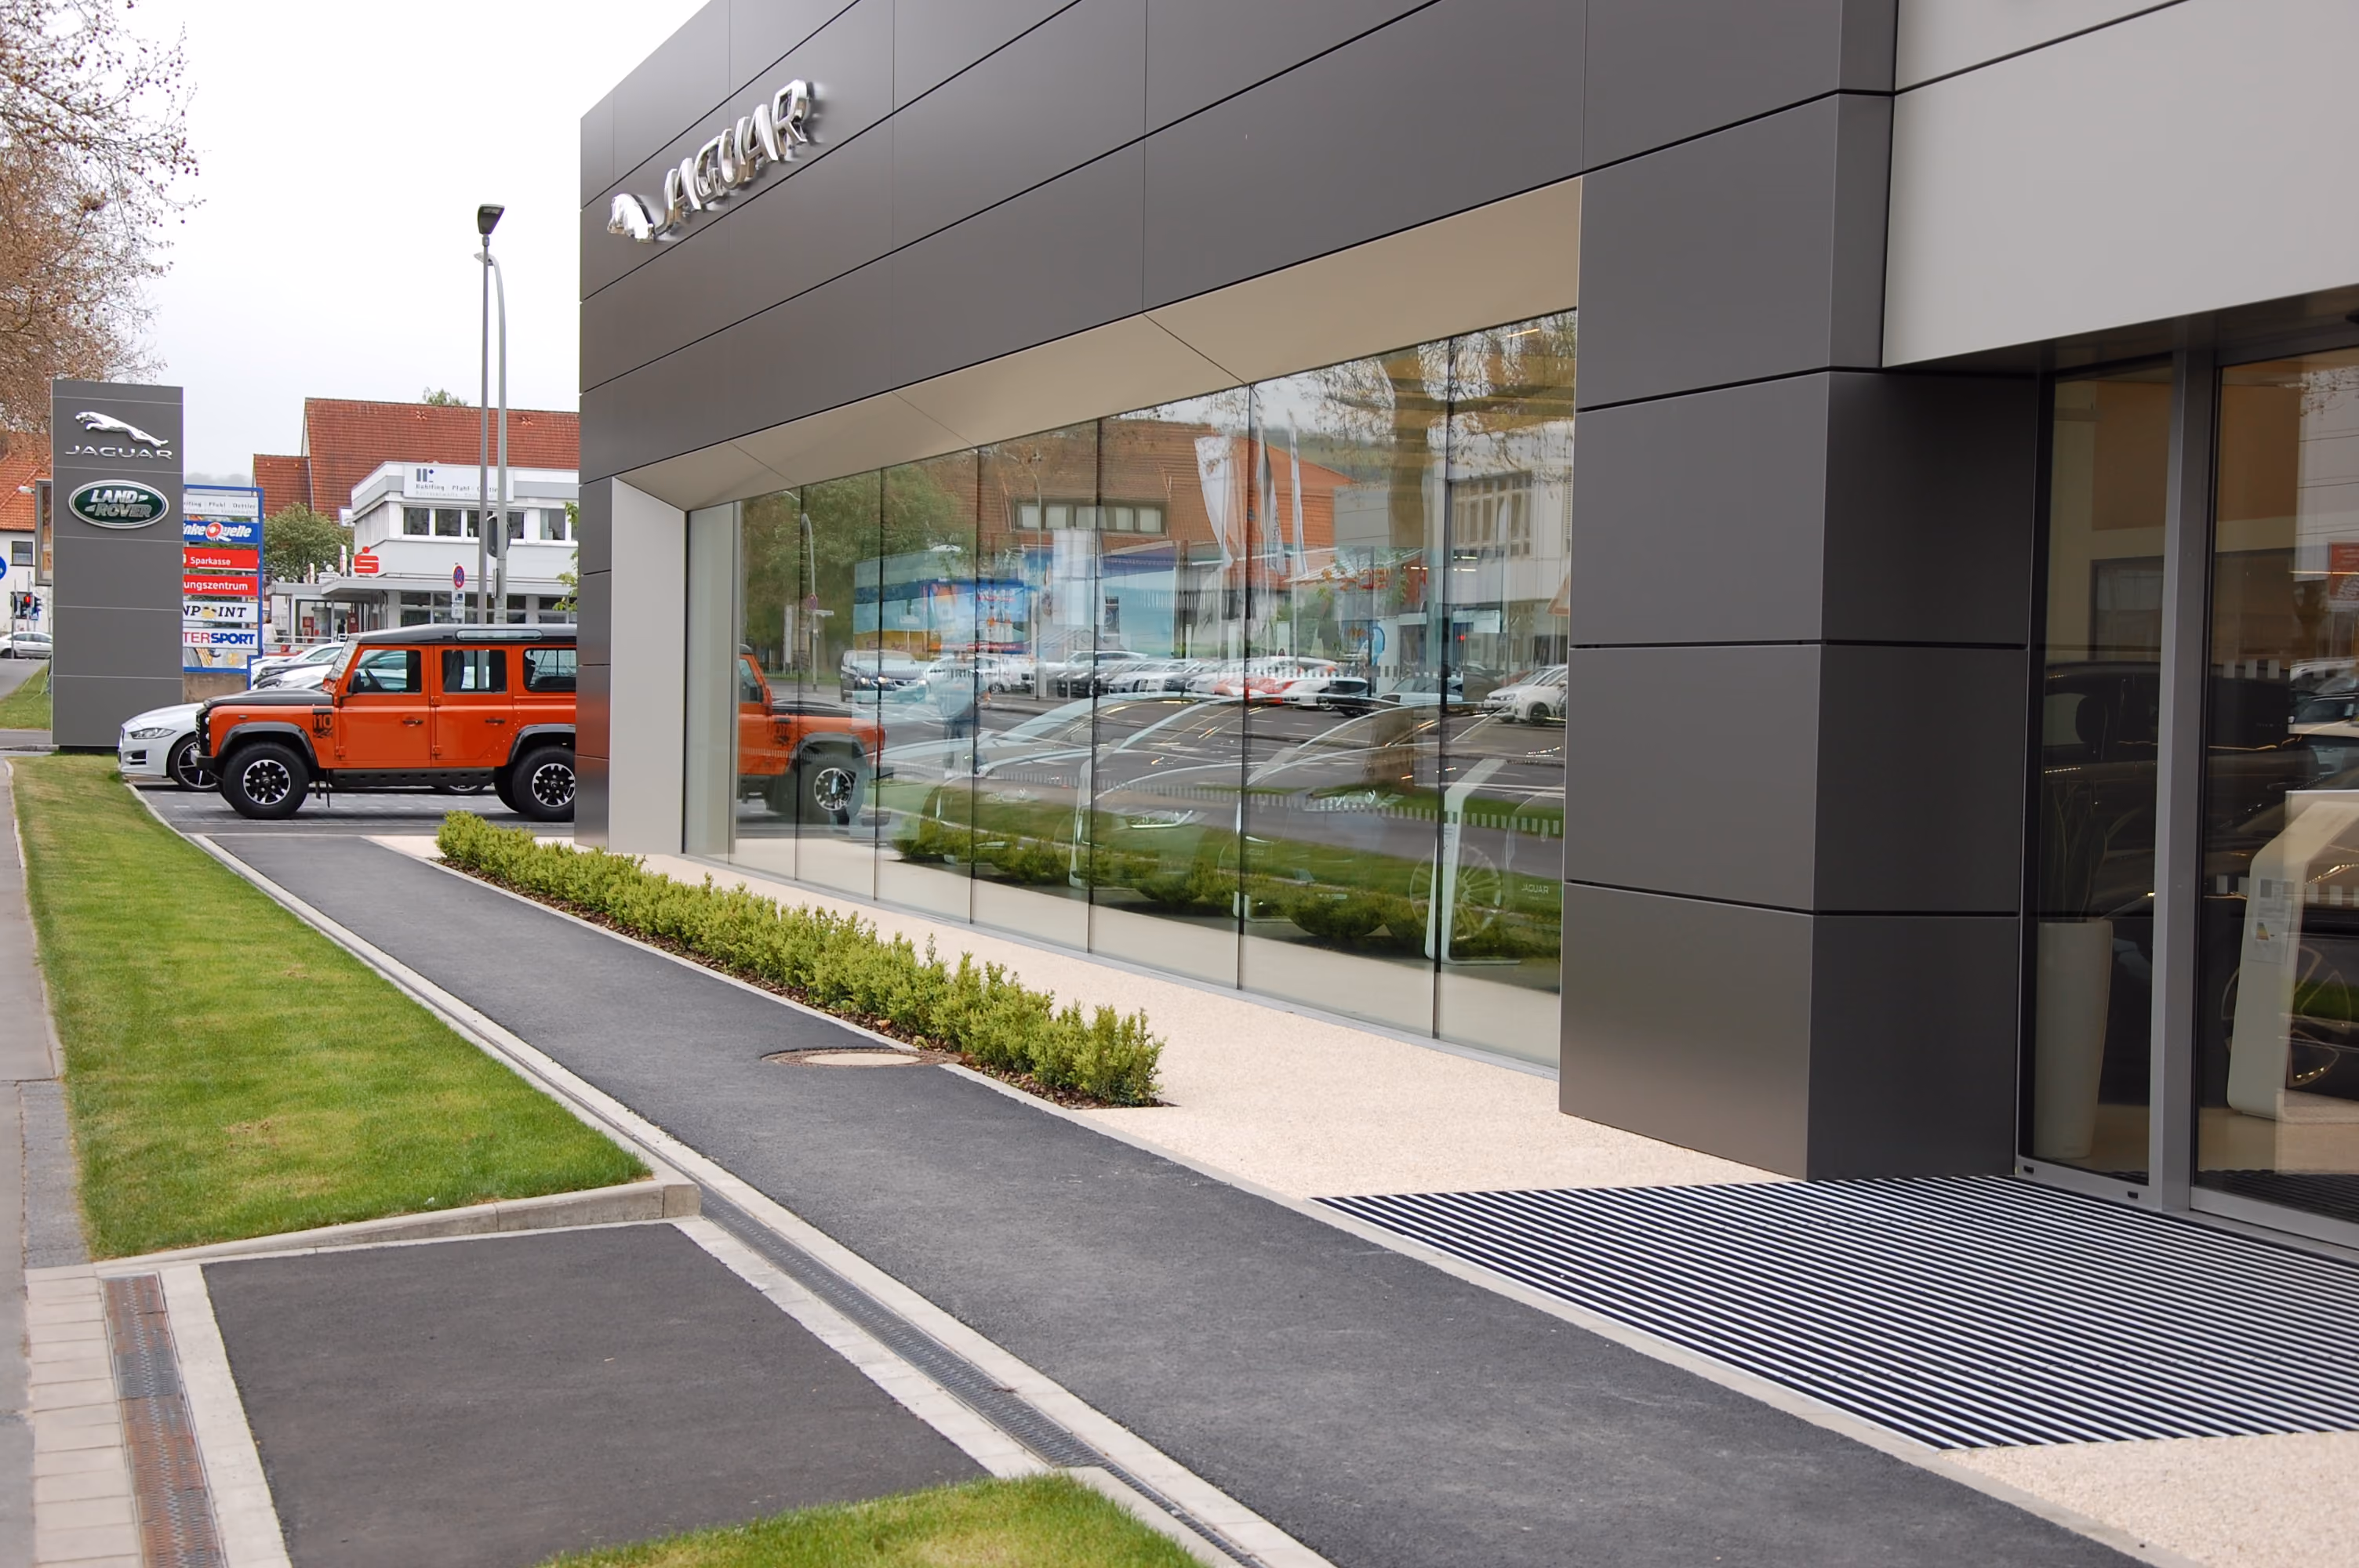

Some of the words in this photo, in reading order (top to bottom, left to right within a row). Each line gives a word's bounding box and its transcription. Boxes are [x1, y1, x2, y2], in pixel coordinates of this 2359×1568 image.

[655, 79, 812, 236] JAGUAR
[65, 445, 173, 459] JAGUAR
[90, 489, 138, 503] LAND
[94, 503, 152, 517] ROVER
[183, 522, 253, 542] nkeQuelle
[190, 556, 231, 566] Sparkasse
[183, 581, 249, 591] ungszentrum
[183, 632, 256, 645] TERSPORT
[314, 714, 333, 728] 110
